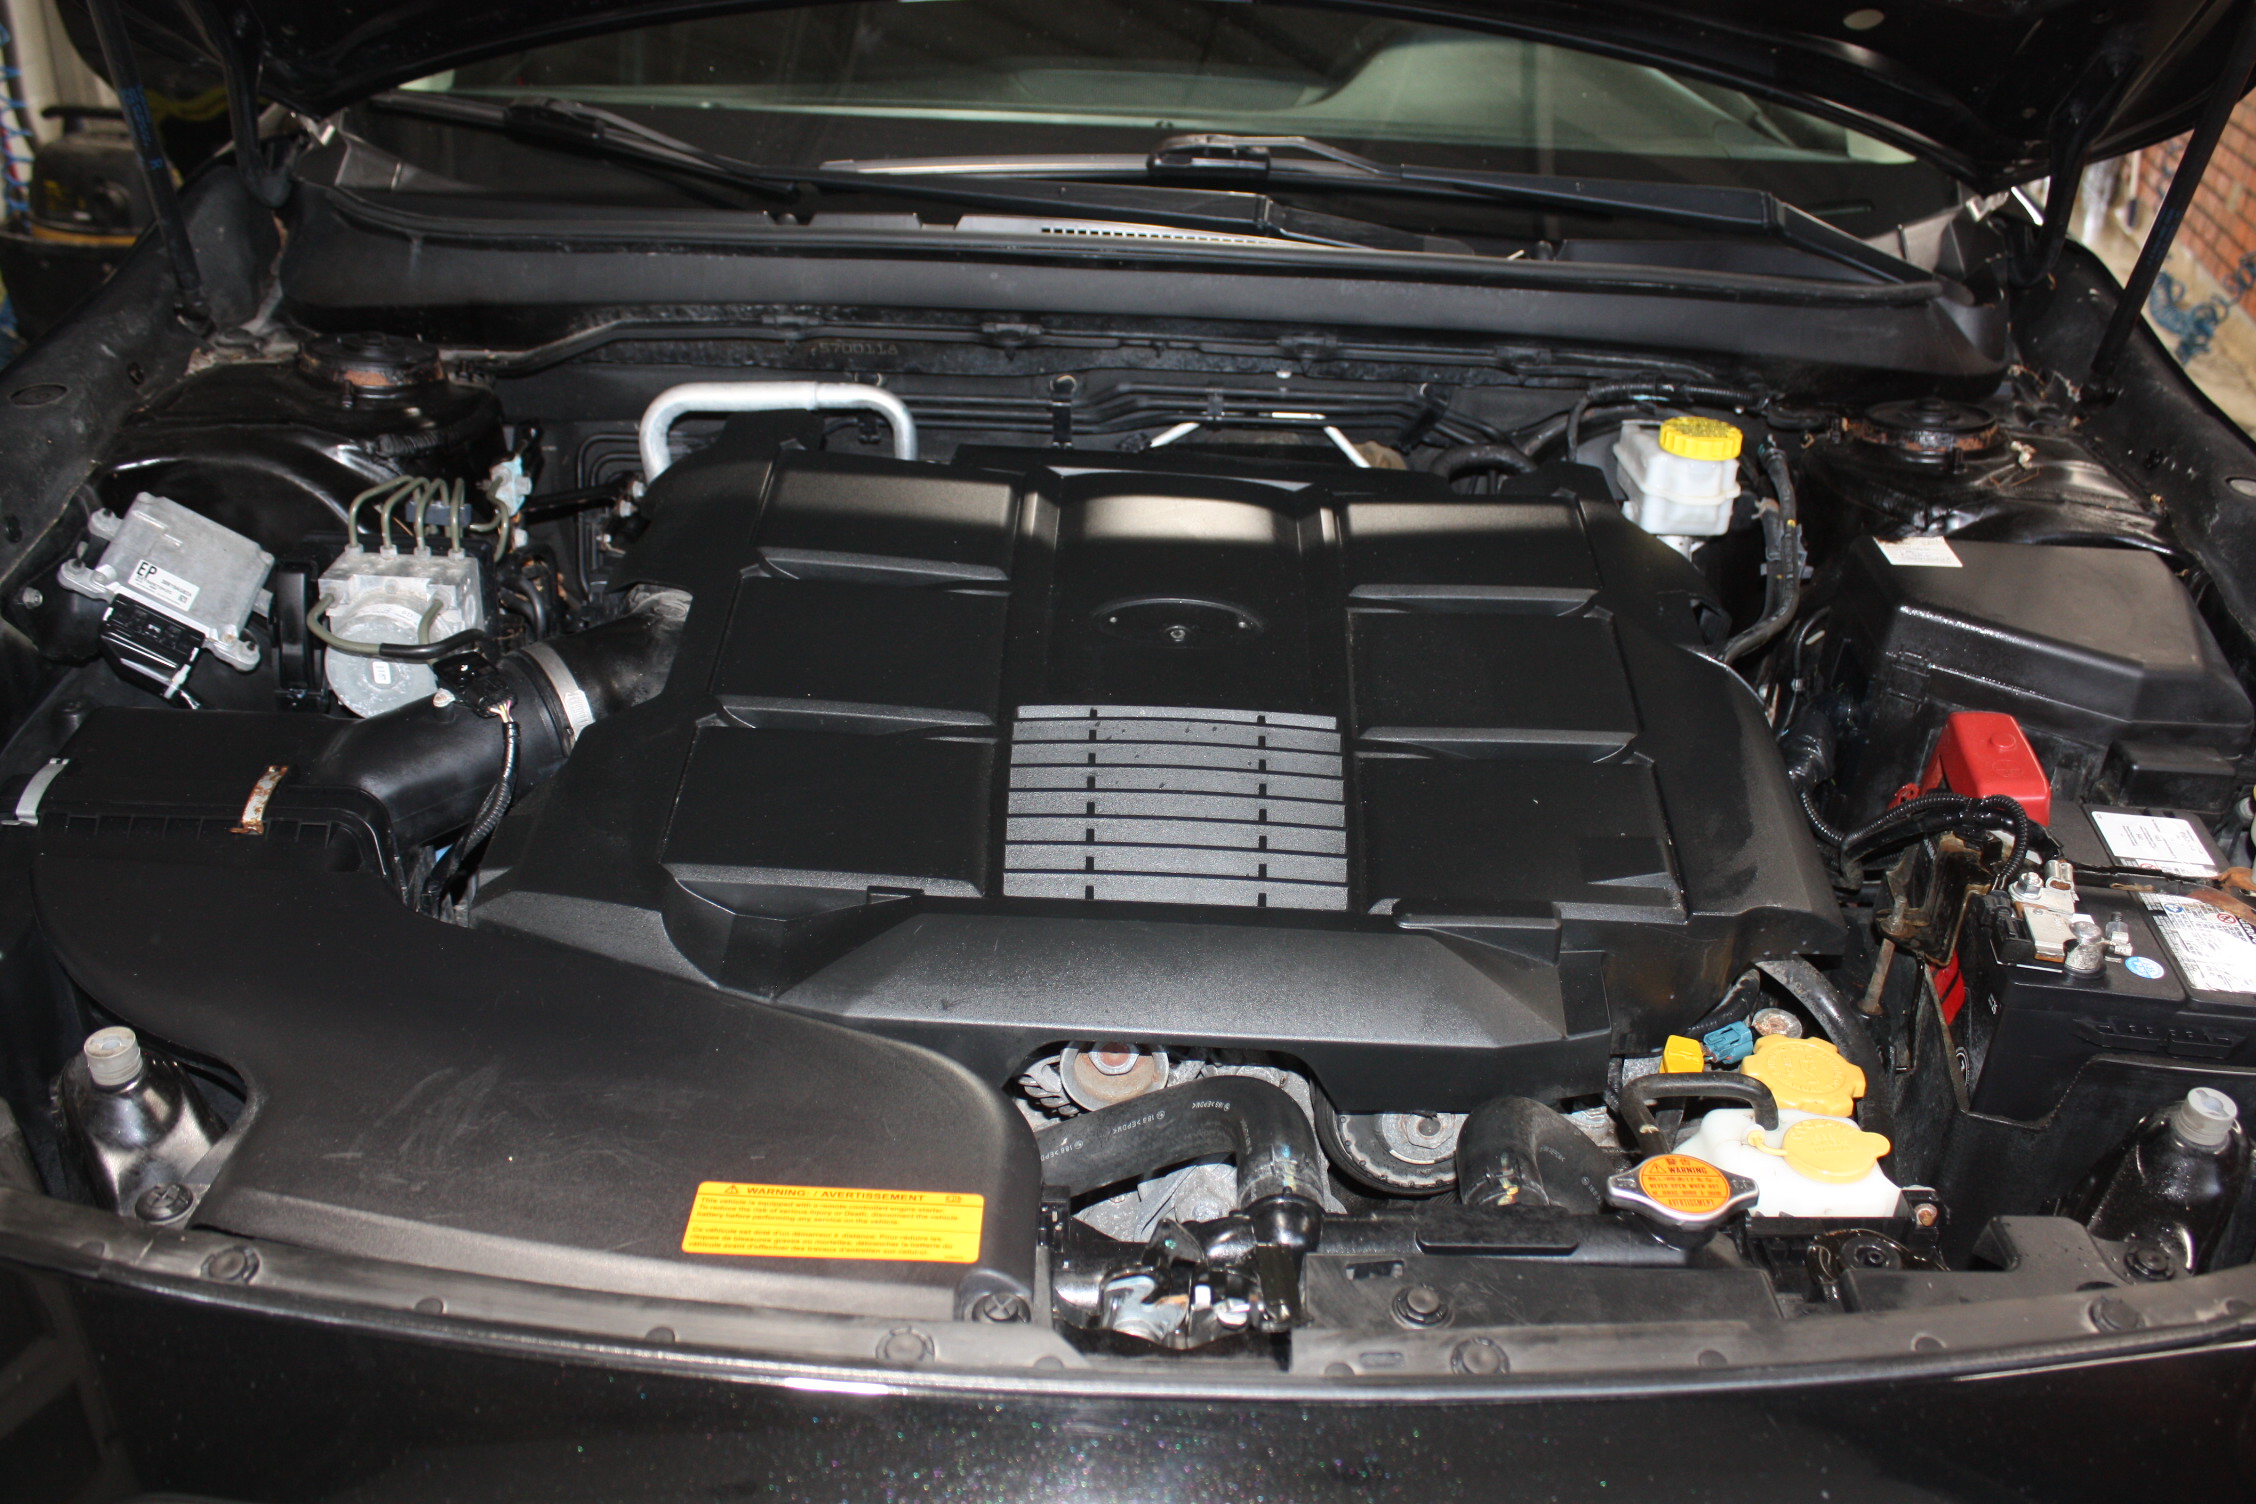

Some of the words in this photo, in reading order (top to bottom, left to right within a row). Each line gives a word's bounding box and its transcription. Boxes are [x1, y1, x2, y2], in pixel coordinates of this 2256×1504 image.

[137, 561, 158, 578] EP
[1668, 1166, 1708, 1174] WARNING
[821, 1191, 925, 1202] AVERTISSEMENT
[710, 1204, 736, 1212] reduce
[871, 1212, 914, 1220] disconnect
[849, 1203, 888, 1211] controlled
[890, 1205, 916, 1214] engine
[697, 1211, 723, 1219] battery
[752, 1214, 795, 1223] performing
